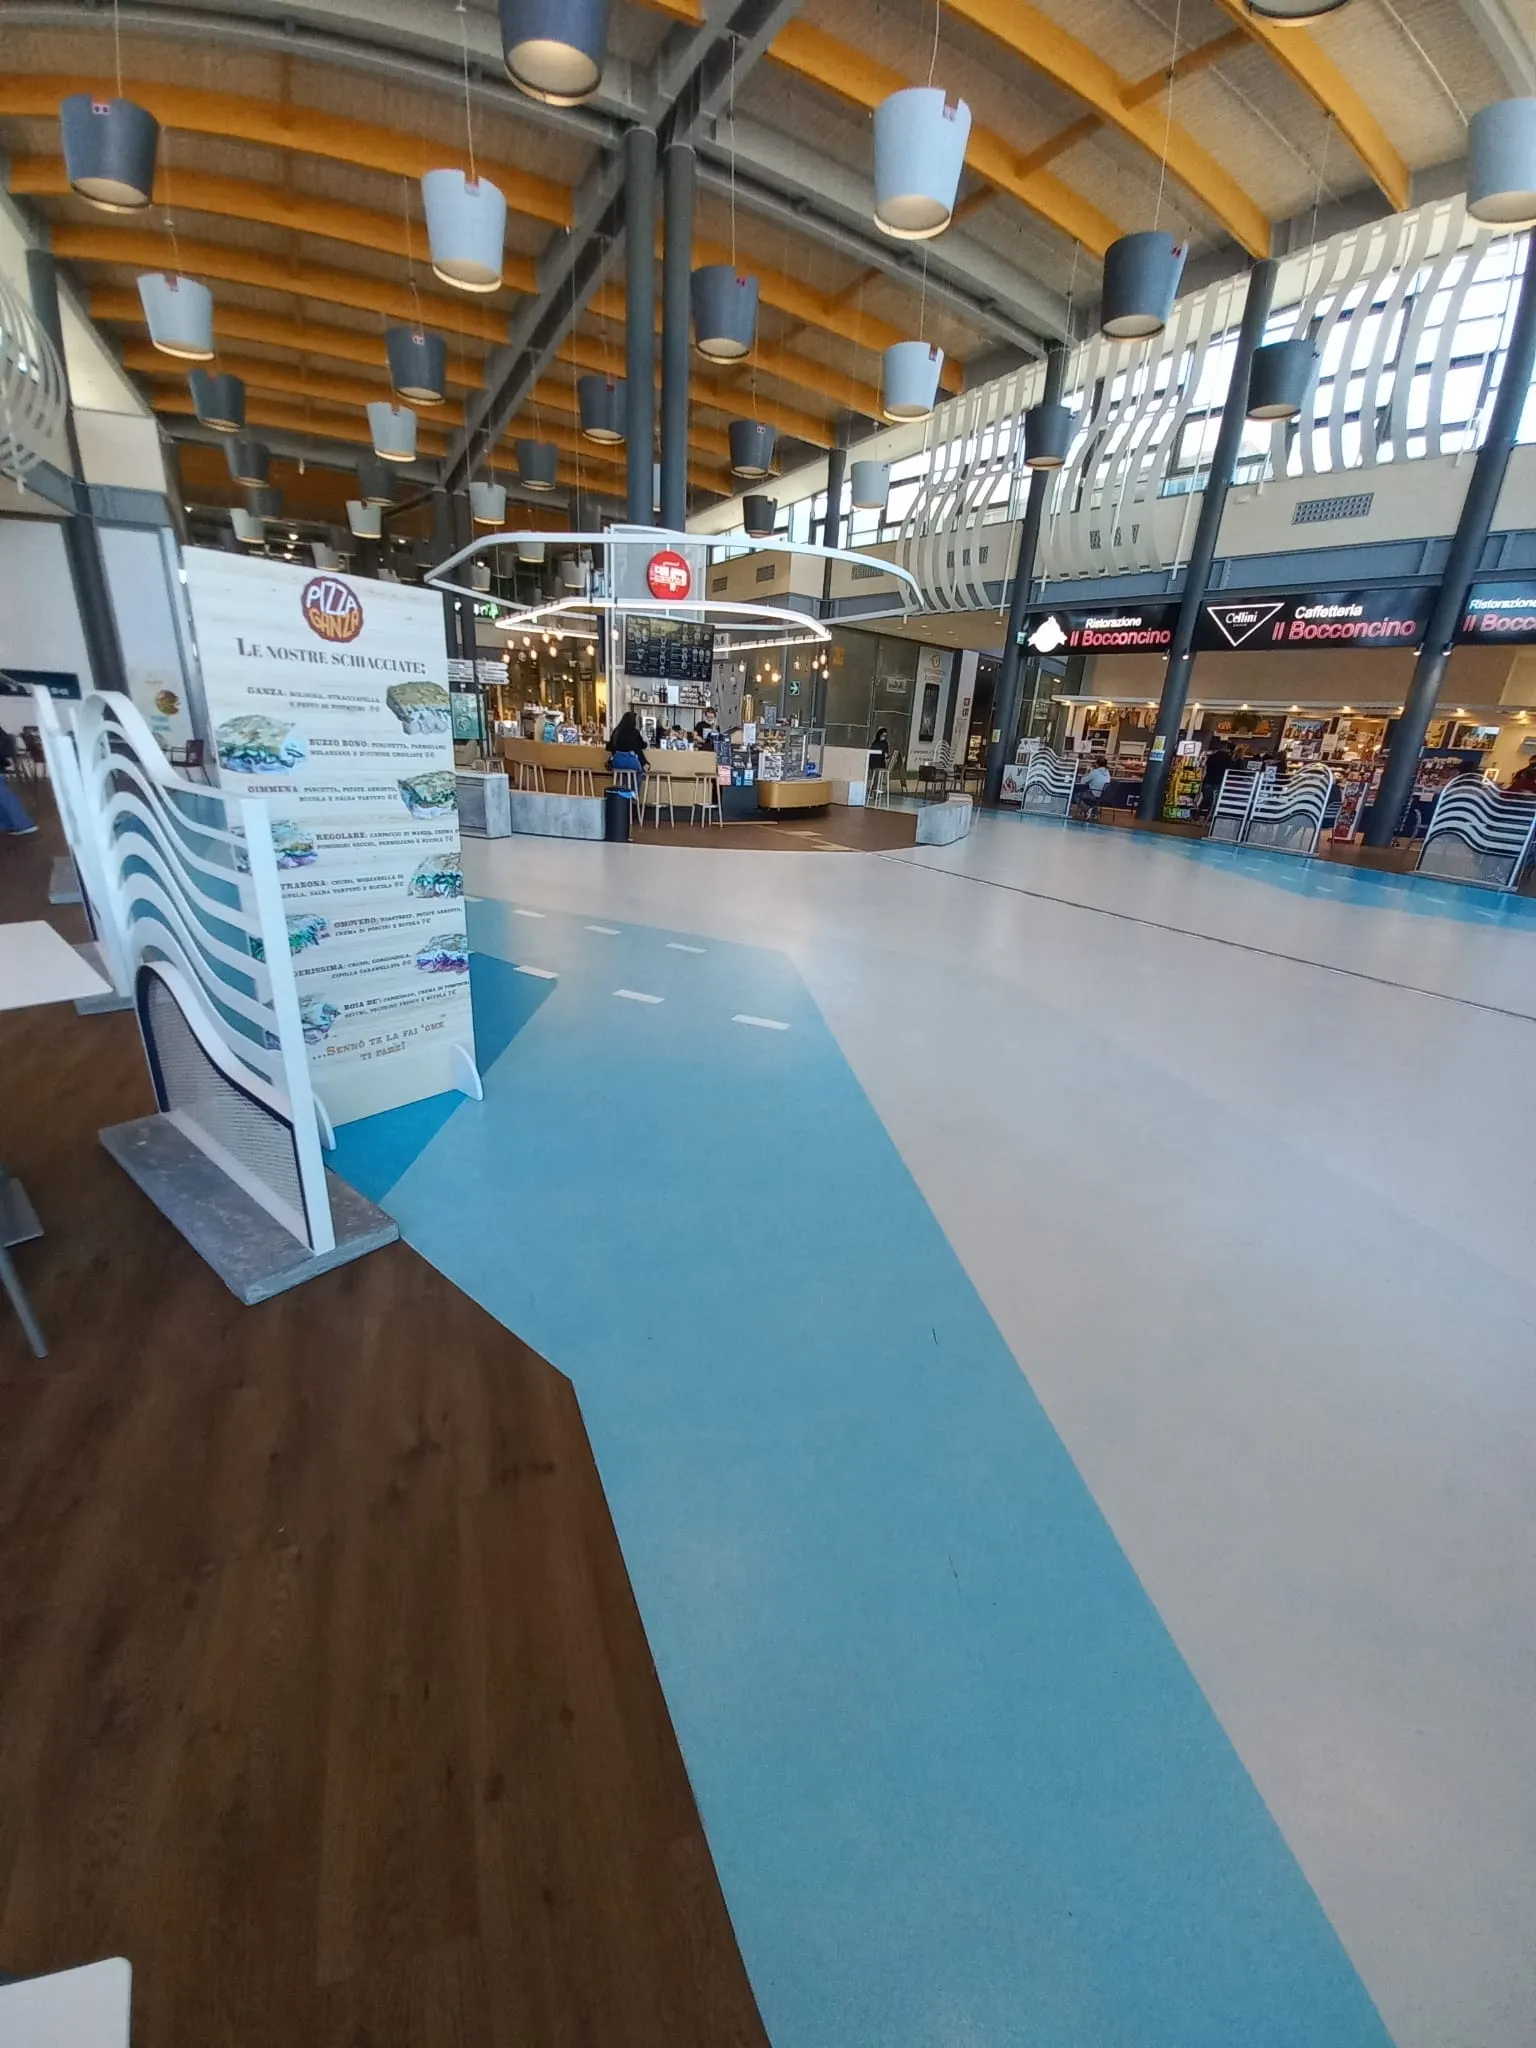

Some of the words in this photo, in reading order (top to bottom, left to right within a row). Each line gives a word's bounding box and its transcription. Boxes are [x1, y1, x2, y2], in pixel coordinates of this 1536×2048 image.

[306, 580, 358, 615] PIZZA
[1225, 611, 1258, 624] Cellini
[1294, 604, 1364, 619] Caffetteria
[309, 608, 360, 639] GANZA
[1085, 616, 1142, 629] Ristorazione
[1272, 622, 1286, 640] Il
[1288, 617, 1416, 640] Bocconcino
[1070, 631, 1080, 646] Il
[1082, 627, 1171, 646] Bocconcino
[236, 638, 263, 658] LE
[266, 645, 328, 664] NOSTRE
[331, 652, 426, 674] SCHIACCIATE:
[316, 832, 368, 841] REGOLARE:
[386, 1033, 400, 1042] LA
[402, 1028, 418, 1038] FAI
